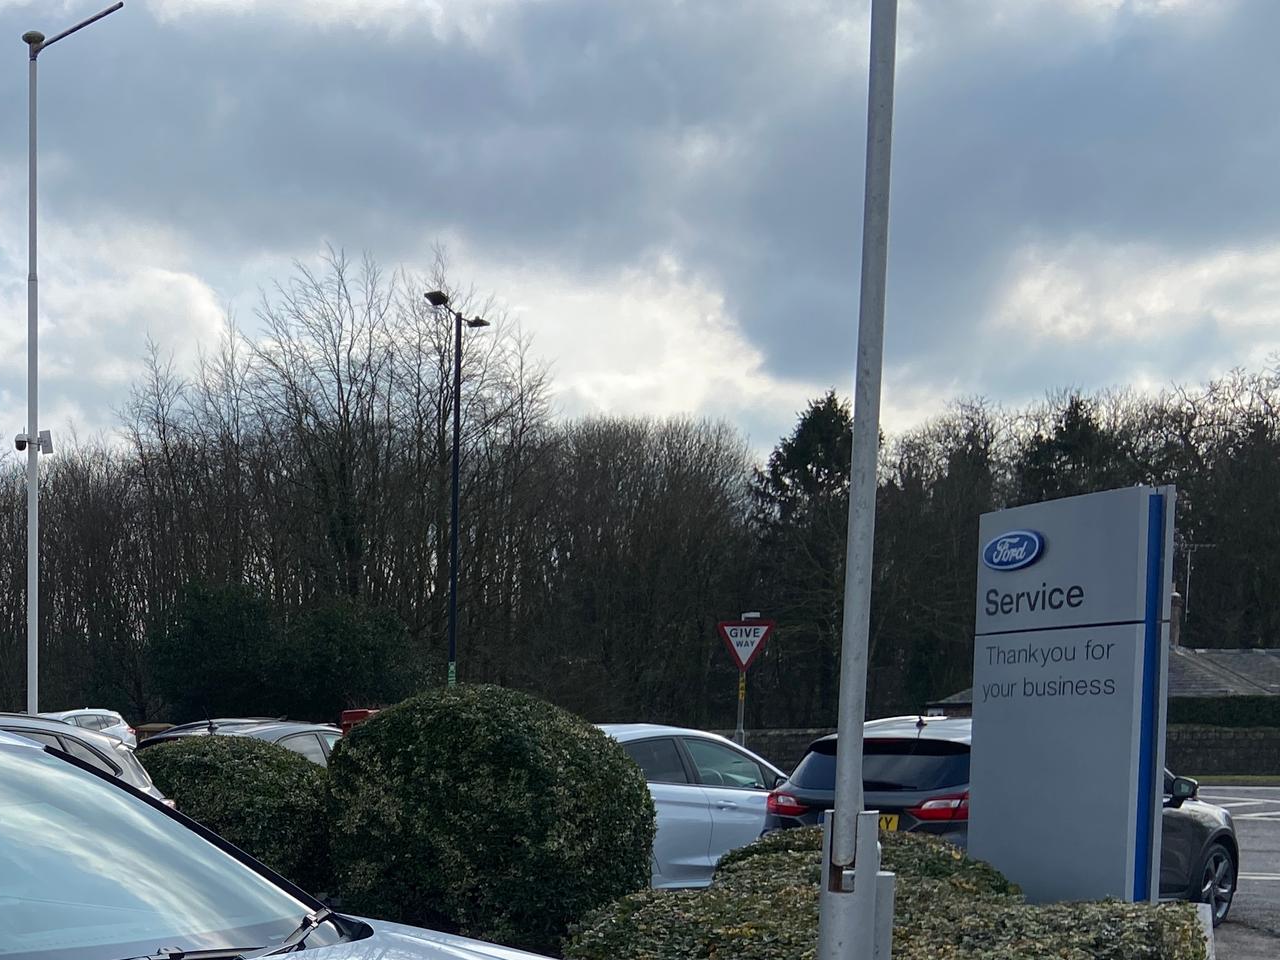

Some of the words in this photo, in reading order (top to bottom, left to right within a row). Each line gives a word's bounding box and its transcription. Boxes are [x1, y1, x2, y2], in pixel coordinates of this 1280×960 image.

[992, 538, 1027, 564] Ford
[985, 582, 1085, 616] Service
[729, 627, 760, 638] GIVE
[735, 640, 755, 648] WAY
[985, 642, 1076, 668] Thankyou
[1085, 639, 1115, 661] for
[982, 681, 1017, 703] your
[1023, 675, 1115, 697] business
